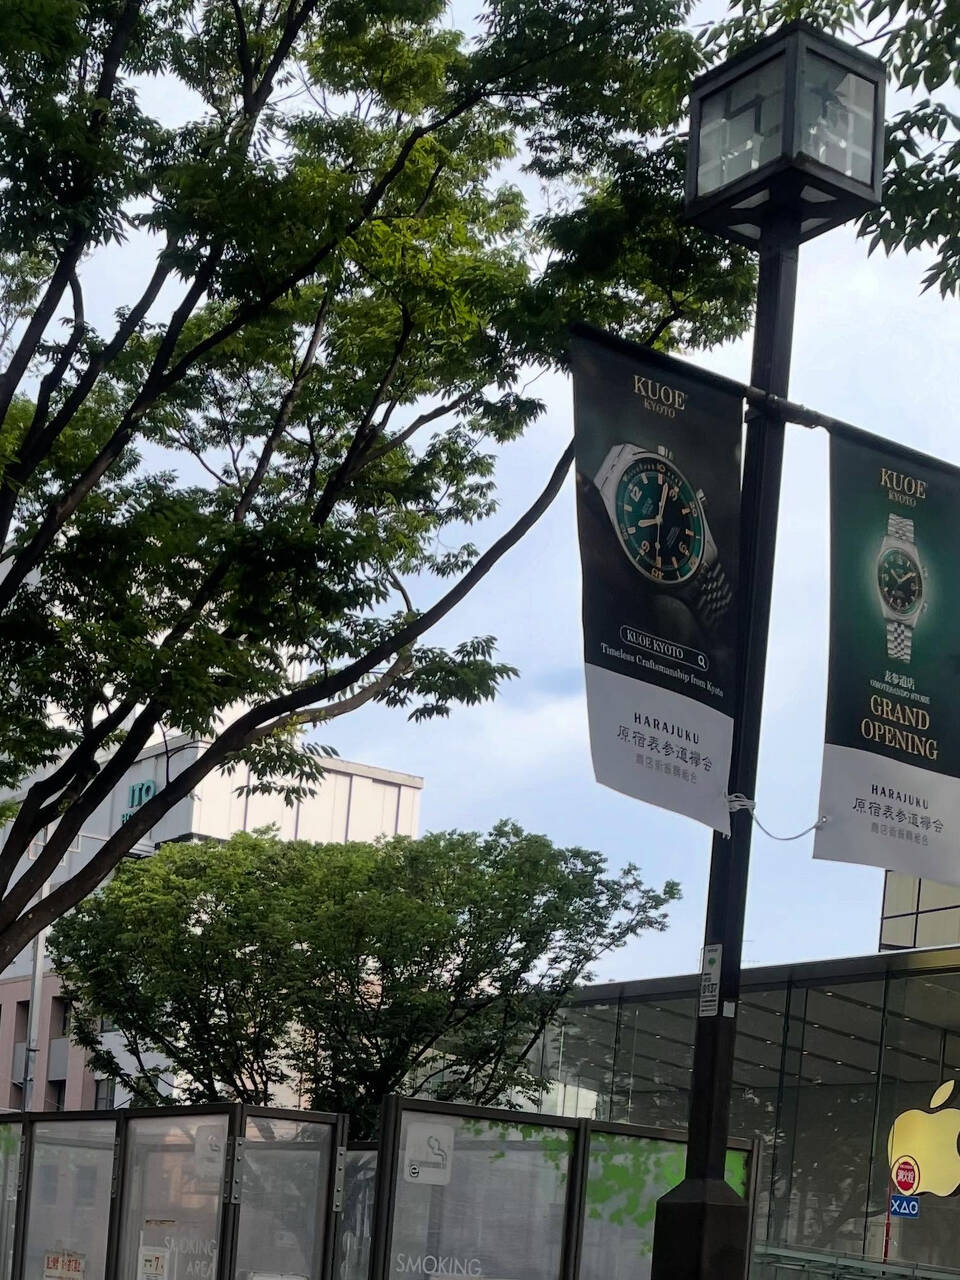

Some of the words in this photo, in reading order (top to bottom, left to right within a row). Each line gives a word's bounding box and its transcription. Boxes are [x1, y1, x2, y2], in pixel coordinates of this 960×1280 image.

[633, 374, 686, 410] KUOE
[643, 398, 676, 418] KYOTO
[880, 468, 927, 499] KUOE
[888, 490, 916, 507] KYOTO
[626, 629, 651, 649] KUOE
[652, 640, 684, 659] KYOTO
[600, 642, 635, 662] Timeless
[636, 655, 690, 682] Craftsmanship
[690, 674, 706, 689] from
[706, 681, 724, 697] Kyoto
[870, 695, 930, 730] GRAND
[633, 711, 700, 745] HARAJUKU
[861, 718, 938, 760] OPENING
[129, 780, 156, 808] ITO
[871, 783, 929, 810] HARAJUKU
[396, 1253, 481, 1277] SMOKING
